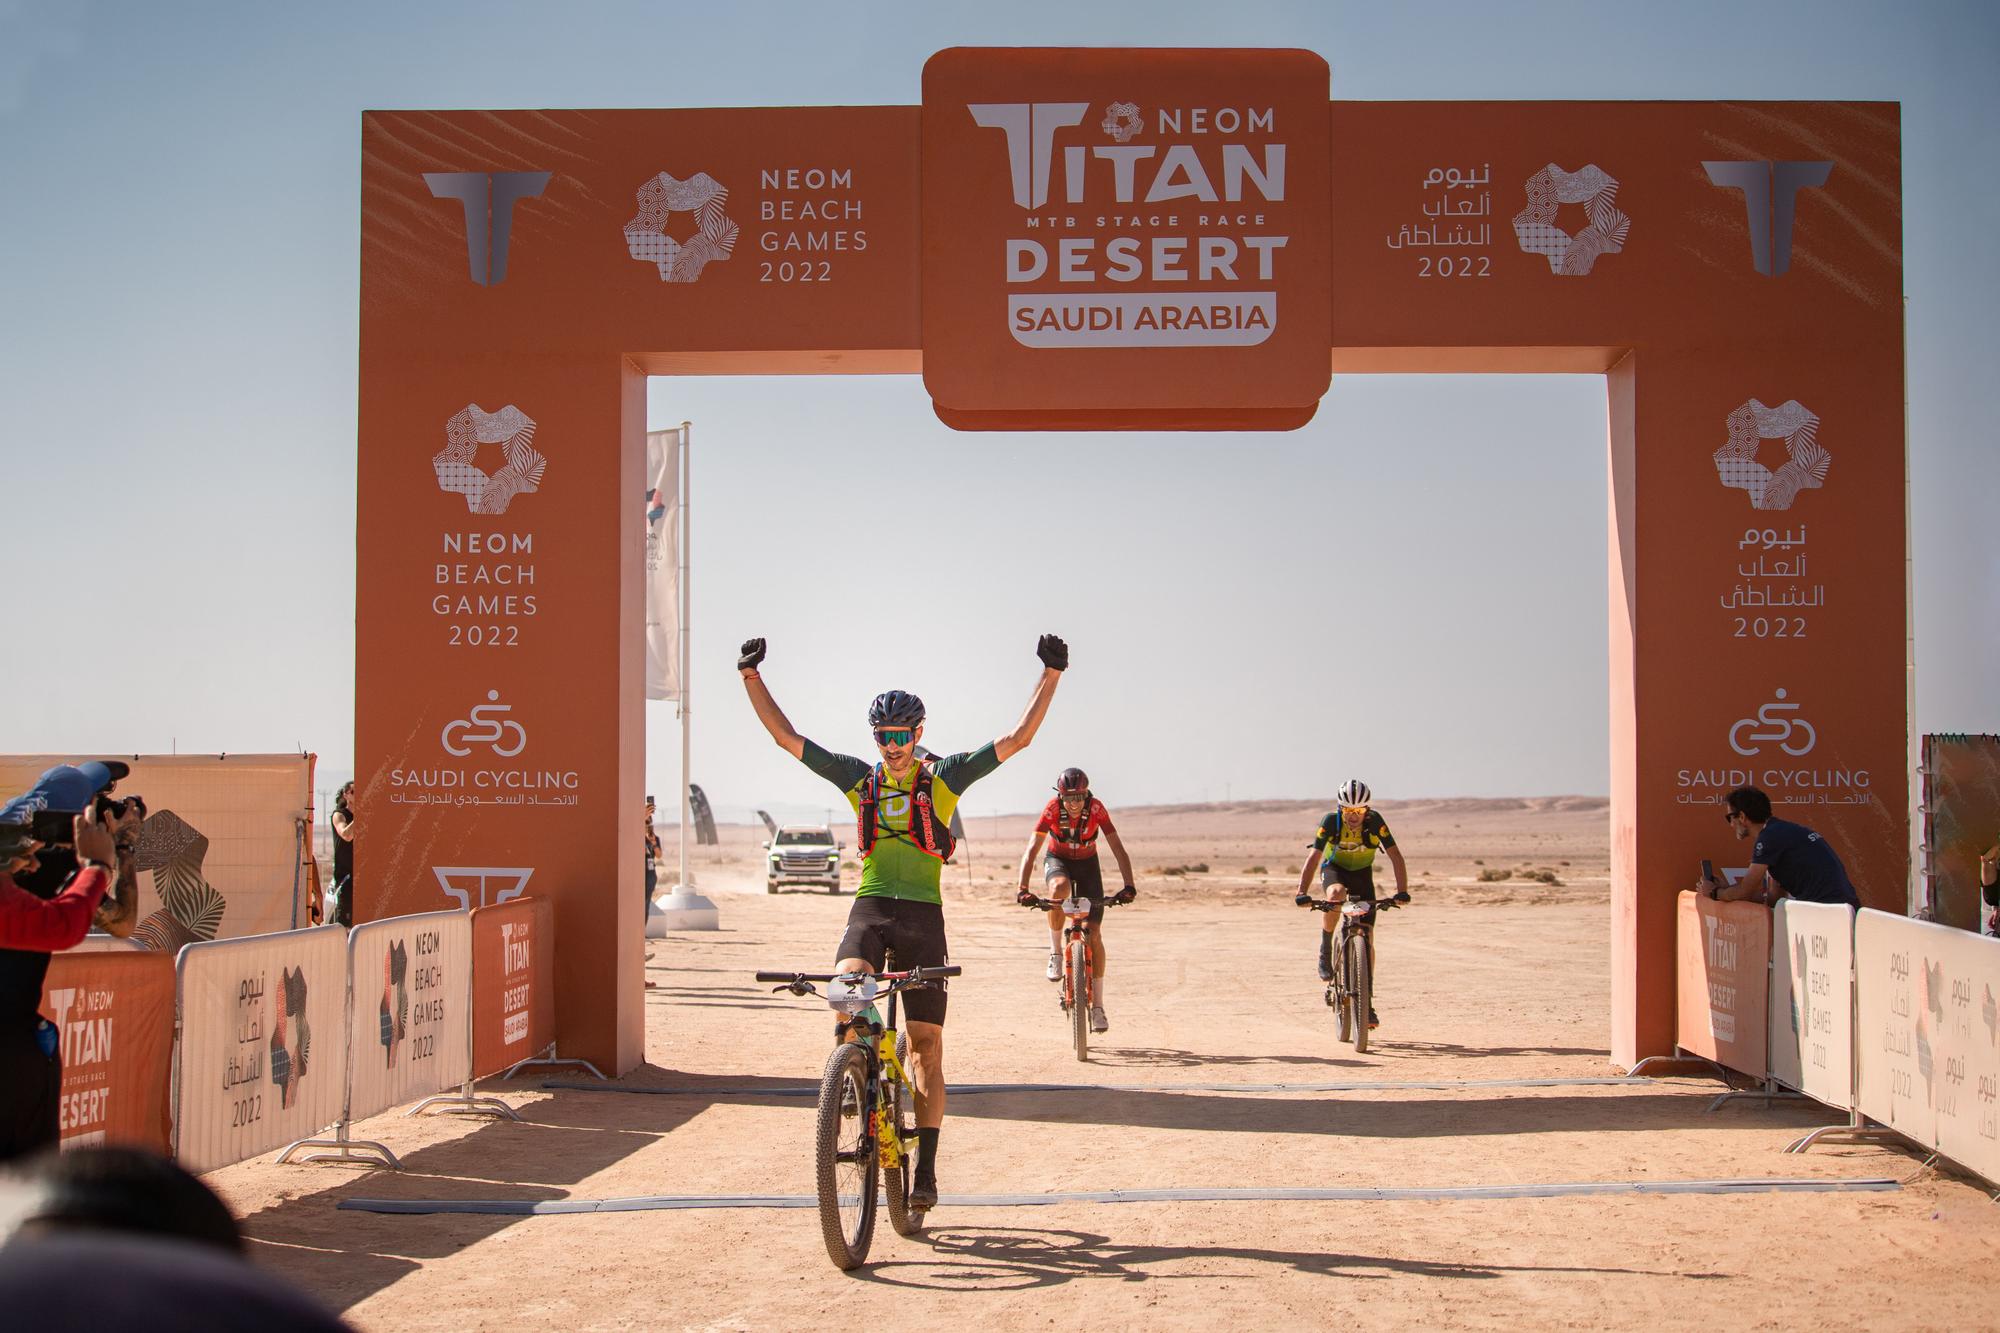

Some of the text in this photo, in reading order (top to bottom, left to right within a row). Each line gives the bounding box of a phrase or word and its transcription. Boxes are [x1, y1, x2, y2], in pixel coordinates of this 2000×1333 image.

[1160, 108, 1274, 135] NEOM
[967, 102, 1287, 210] TITAN
[761, 169, 852, 190] NEOM
[1423, 163, 1490, 190] نيوم
[761, 200, 862, 221] BEACH
[1422, 192, 1491, 216] ألعاب
[1027, 214, 1265, 228] MTB STAGE RACE
[760, 231, 867, 252] GAMES
[760, 262, 831, 282] 2022
[1006, 236, 1289, 283] DESERT
[1418, 256, 1491, 278] 2022
[1015, 305, 1270, 332] SAUDI ARABIA
[443, 533, 532, 554] NEOM
[1739, 524, 1806, 550] نيوم
[435, 565, 534, 585] BEACH
[1738, 553, 1806, 583] ألعاب
[432, 595, 537, 616] GAMES
[448, 625, 519, 646] 2022
[1733, 617, 1806, 638] 2022
[391, 769, 578, 789] SAUDI CYCLING
[1677, 769, 1870, 788] SAUDI CYCLING
[415, 931, 440, 957] NEOM
[501, 922, 530, 976] TITAN
[1705, 914, 1737, 972] TITAN
[1811, 934, 1828, 960] NEOM
[415, 966, 442, 992] BEACH
[1890, 951, 1909, 982] نيوم
[239, 970, 265, 1008] نيوم
[1709, 982, 1736, 1011] DESERT
[1811, 970, 1830, 997] BEACH
[87, 991, 114, 1012] NEOM
[504, 983, 530, 1014] DESERT
[413, 999, 444, 1026] GAMES
[1812, 1007, 1832, 1034] GAMES
[49, 987, 113, 1068] TITAN
[412, 1035, 434, 1062] 2022
[1813, 1042, 1827, 1070] 2022
[1891, 1067, 1912, 1099] 2022
[60, 1087, 110, 1131] ESERT
[232, 1094, 262, 1128] 2022
